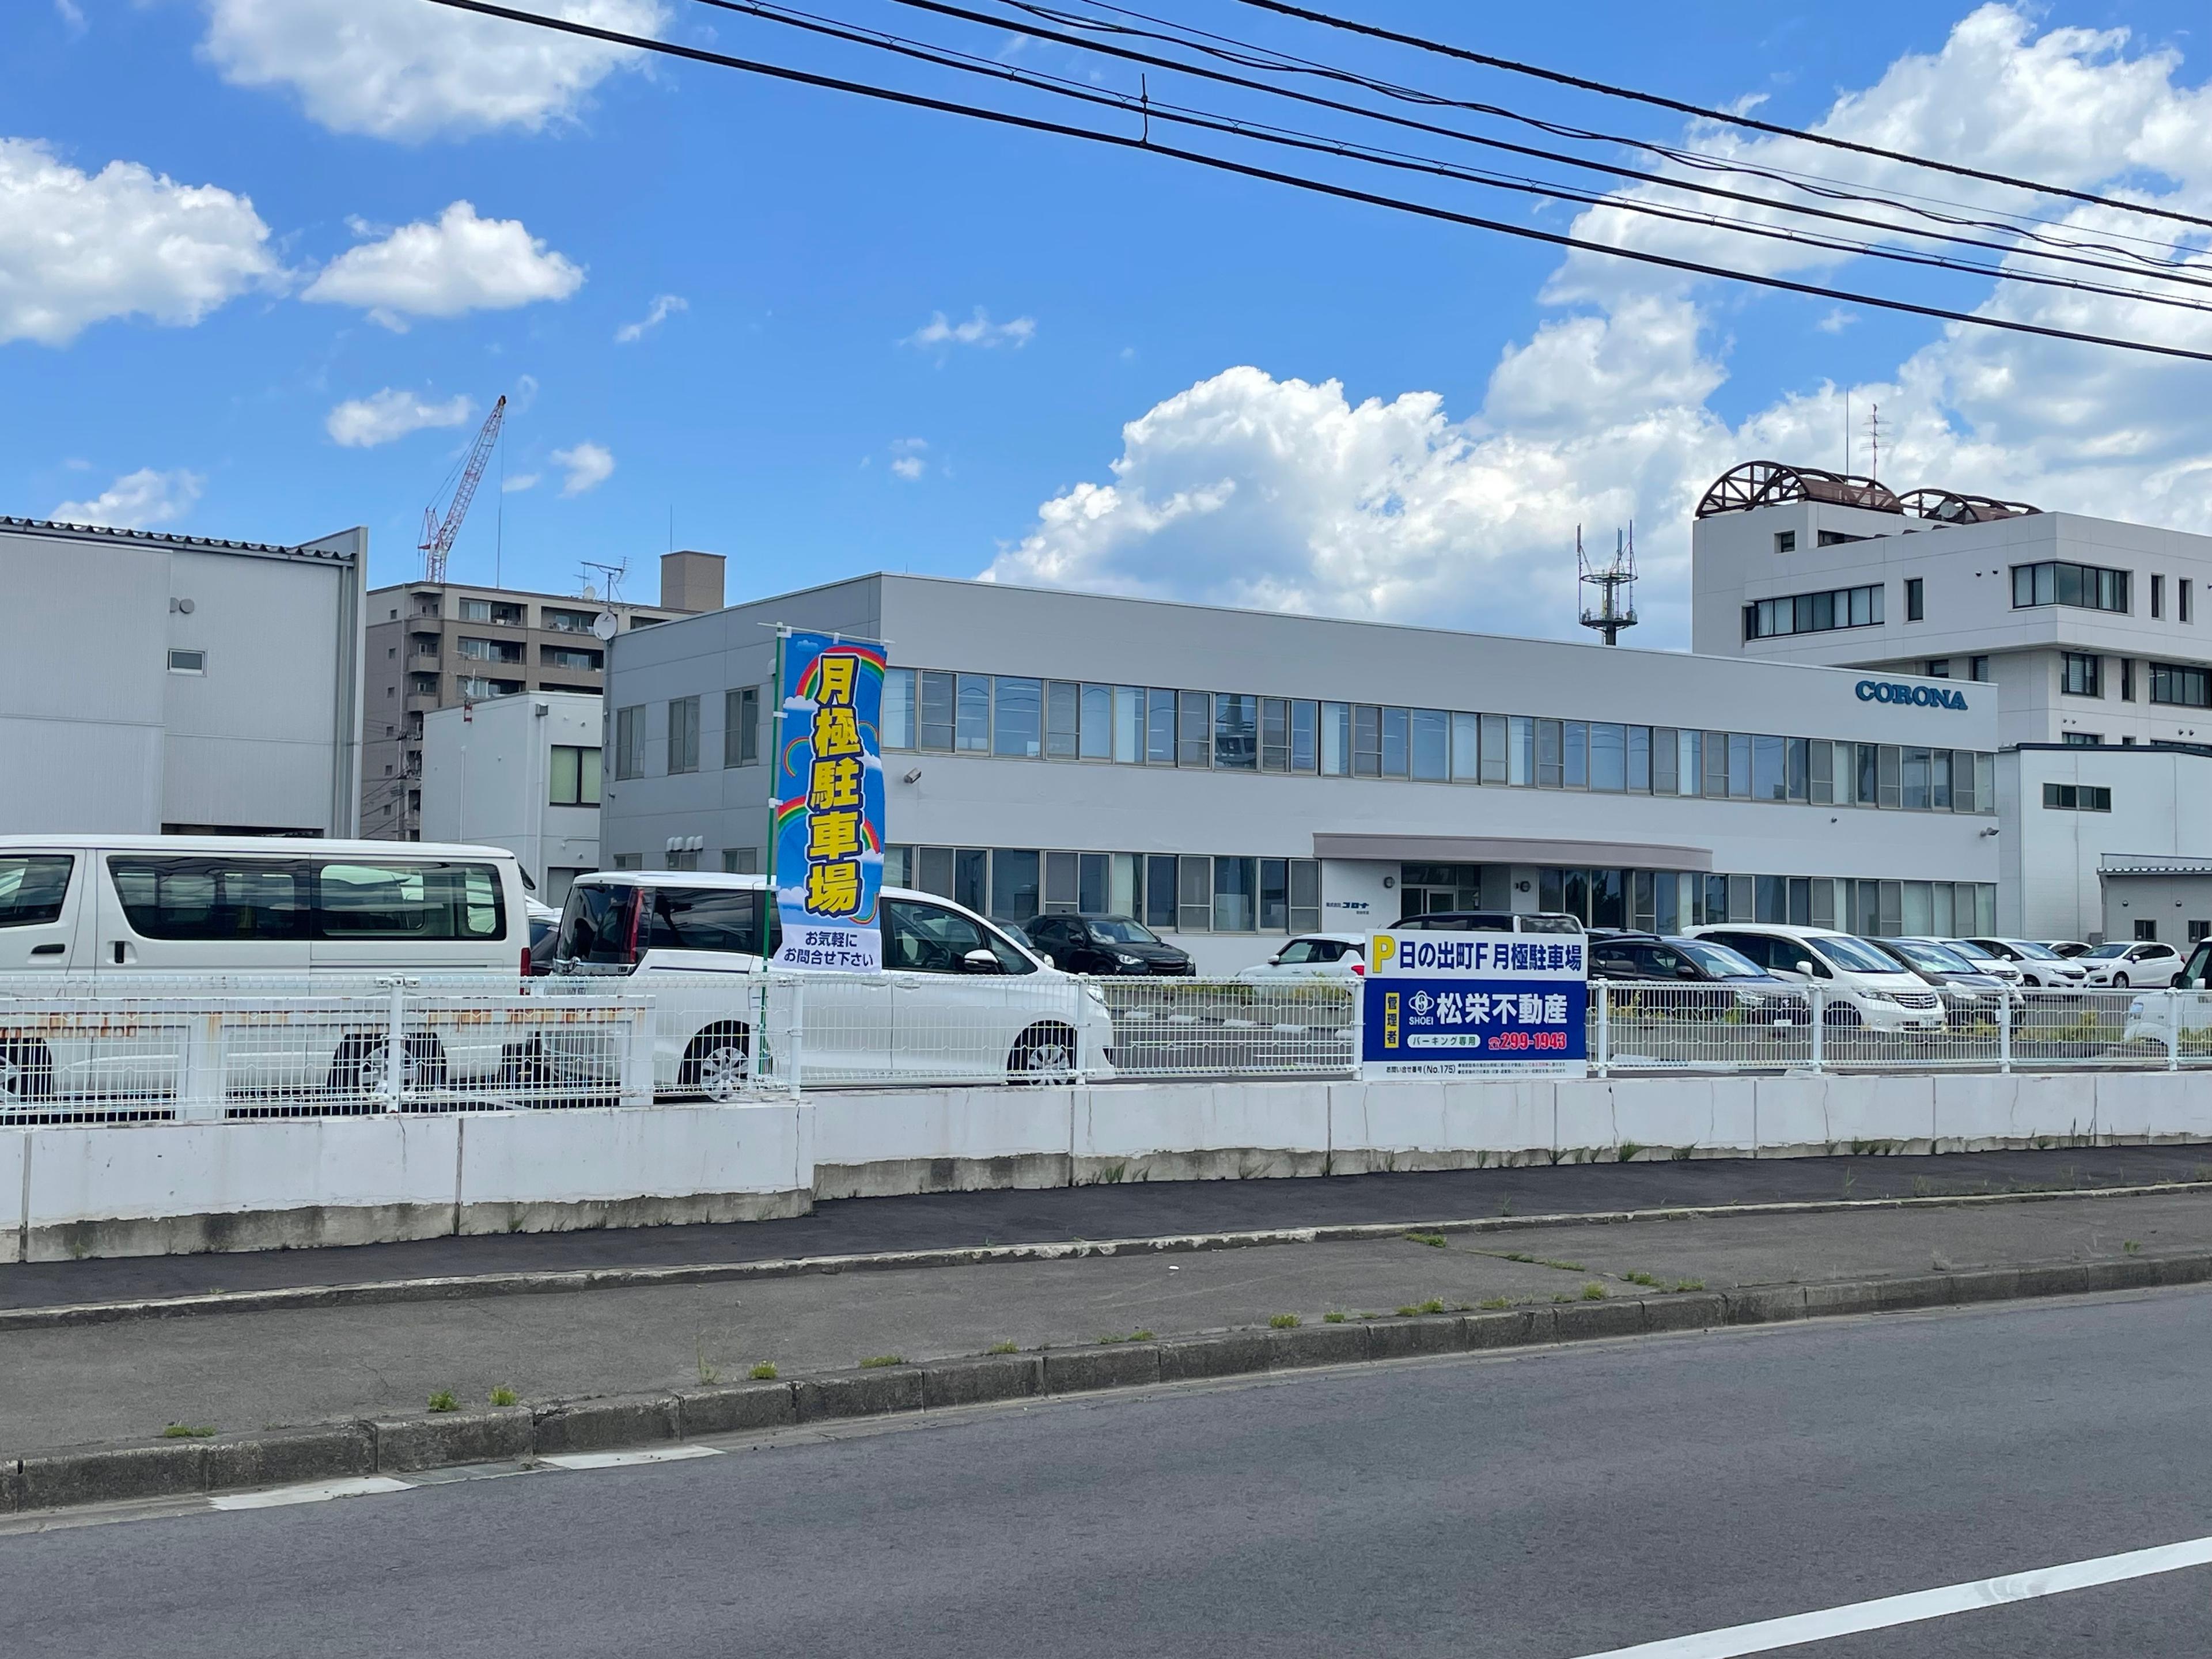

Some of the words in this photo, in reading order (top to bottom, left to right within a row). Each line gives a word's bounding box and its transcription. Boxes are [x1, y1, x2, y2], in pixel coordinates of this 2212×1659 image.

[1855, 680, 1968, 710] CORONA
[806, 654, 863, 914] 月極駐車場
[805, 931, 858, 947] お気軽に
[783, 948, 874, 967] お問合せ下さい
[1372, 935, 1396, 974] P
[1400, 941, 1488, 969] 日の出町F
[1493, 942, 1582, 971] 月極駐車場
[1387, 996, 1397, 1044] 管理者
[1409, 1016, 1434, 1025] SHOEI
[1437, 993, 1567, 1025] 松栄不動産
[1412, 1036, 1476, 1046] パーキング専用
[1500, 1032, 1567, 1050] 299-1943
